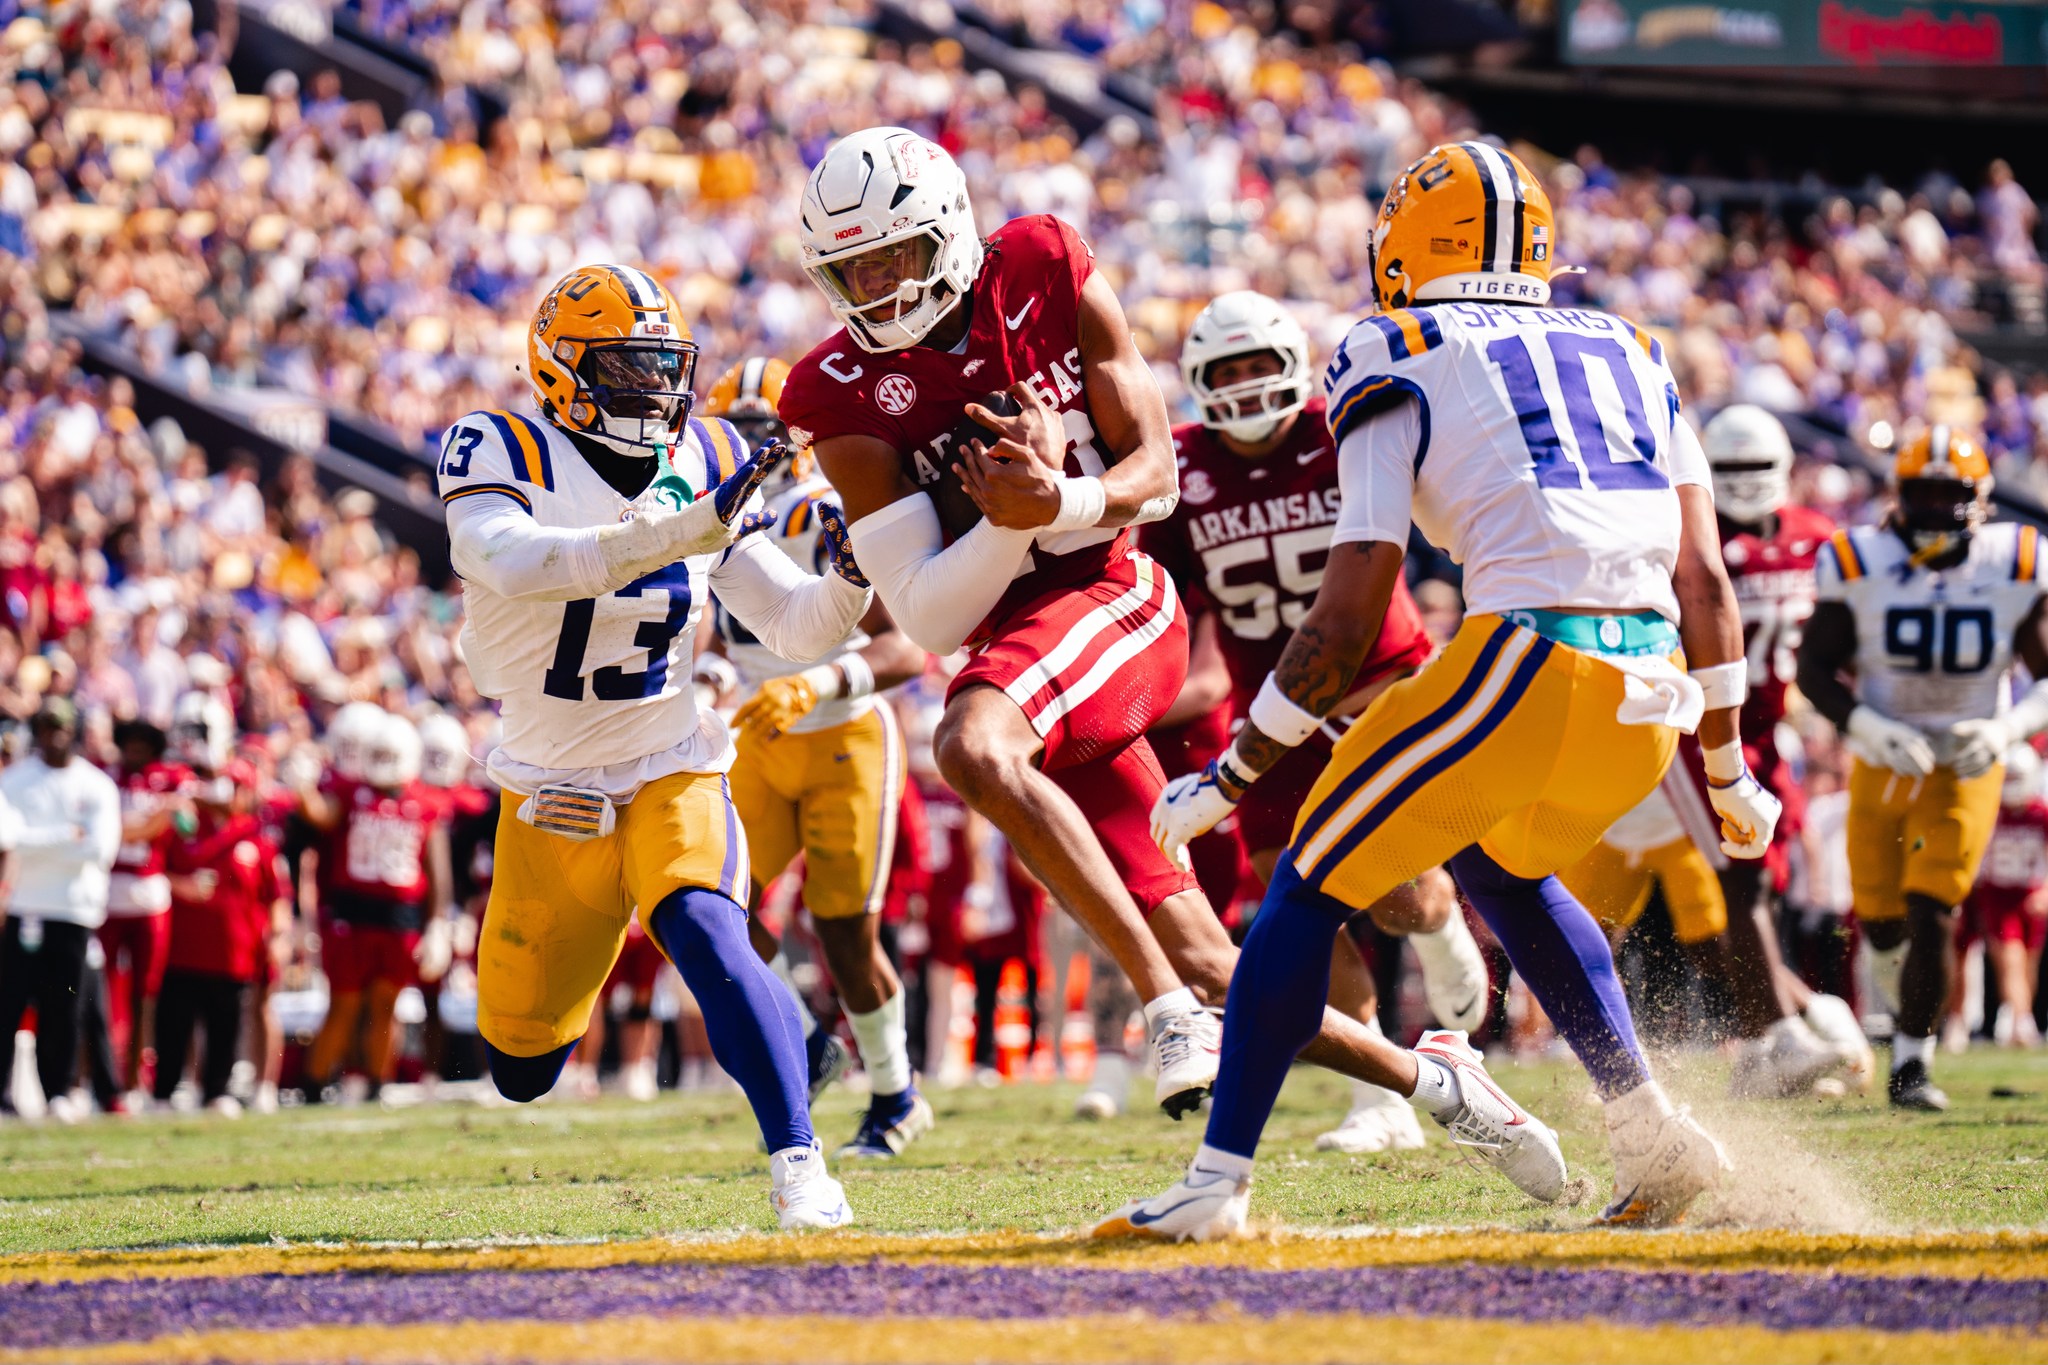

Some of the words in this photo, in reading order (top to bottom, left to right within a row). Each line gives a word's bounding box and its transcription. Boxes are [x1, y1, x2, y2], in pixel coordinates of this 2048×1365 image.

[834, 225, 863, 241] HOGS
[1459, 281, 1541, 298] TIGERS
[644, 323, 670, 335] LSU
[1453, 304, 1614, 331] SPEARS
[819, 352, 863, 383] C
[878, 377, 914, 412] SEC
[1486, 331, 1669, 491] 10
[439, 424, 484, 477] 13
[1188, 486, 1342, 550] ARKANSAS
[1201, 524, 1337, 640] 55
[543, 561, 692, 701] 13
[1886, 608, 1994, 674] 90
[787, 1154, 808, 1163] LSU
